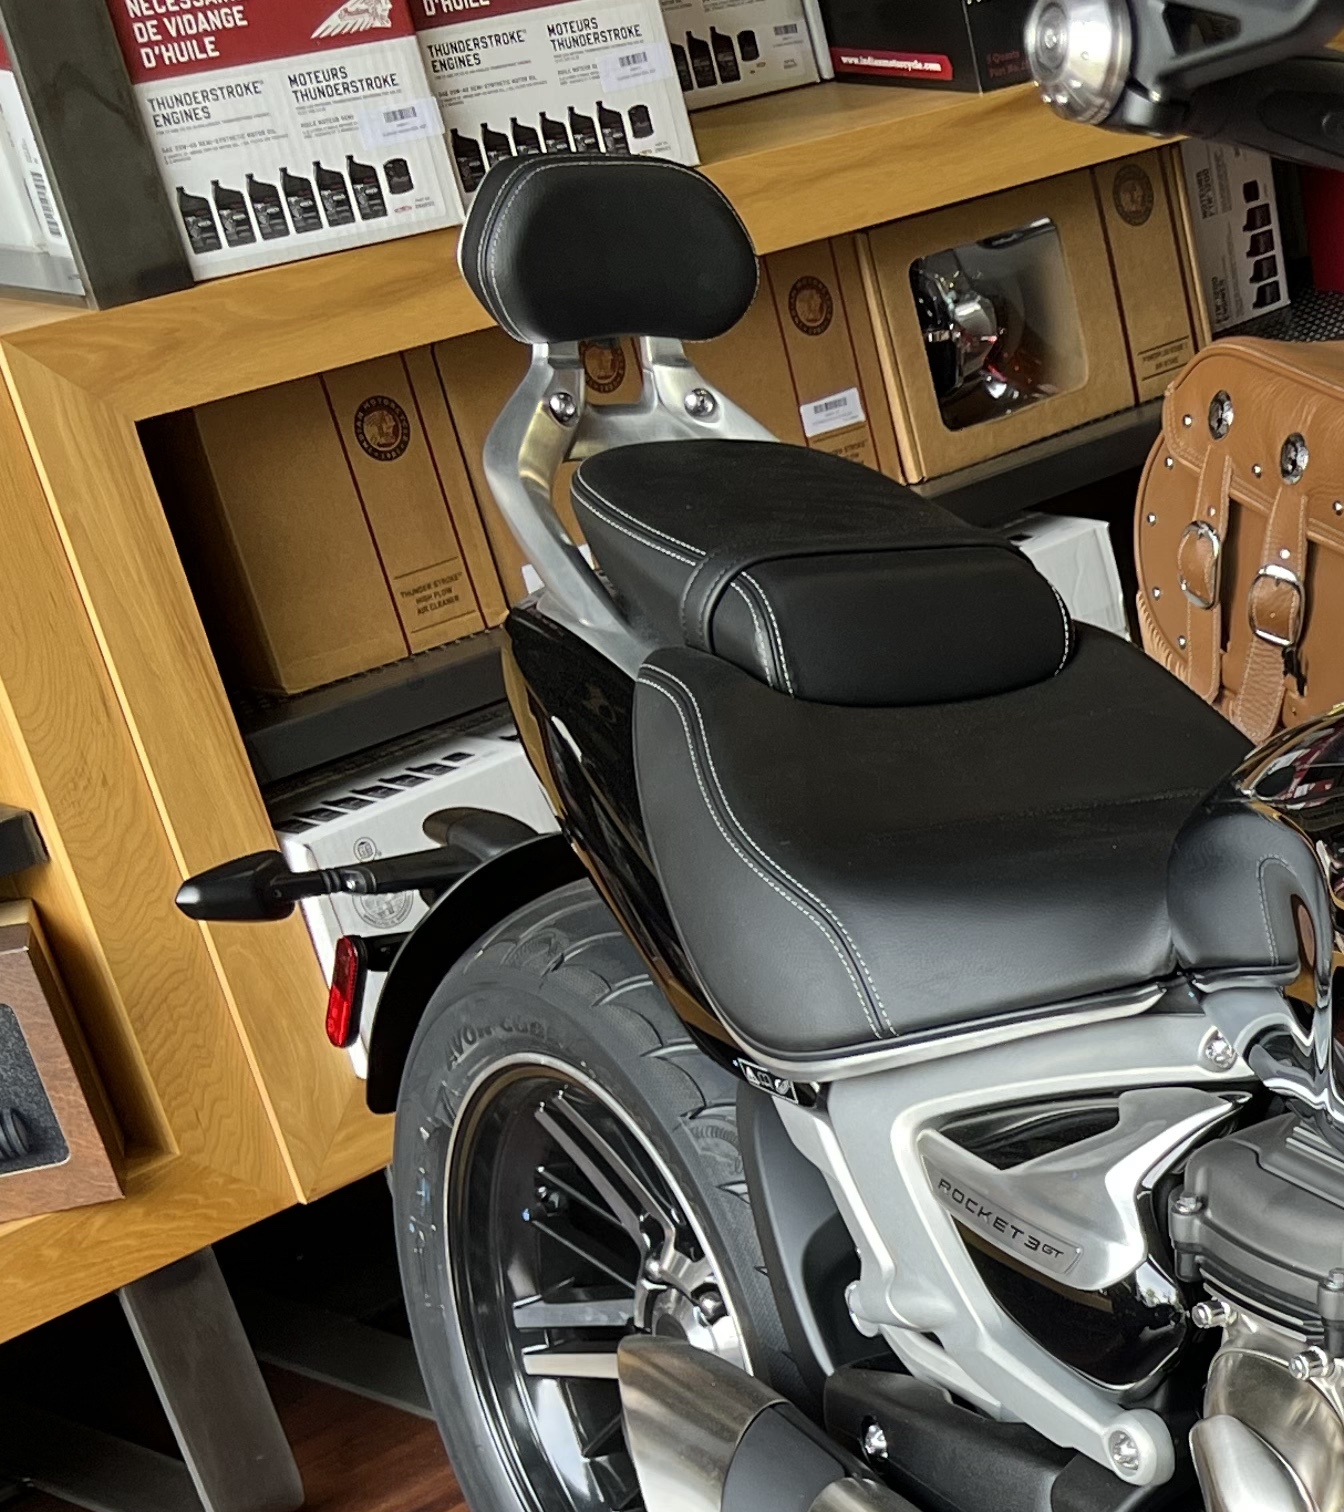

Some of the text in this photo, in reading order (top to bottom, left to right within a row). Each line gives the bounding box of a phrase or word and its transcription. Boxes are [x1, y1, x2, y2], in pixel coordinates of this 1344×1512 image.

[132, 5, 248, 43] DE VIDANGE
[547, 17, 598, 37] MOTEURS
[550, 24, 642, 51] THUNDERSTROKE
[140, 36, 220, 69] D'HUILE
[427, 31, 525, 58] THUNDERSTROKE
[431, 53, 481, 73] ENGINES
[287, 66, 348, 88] MOTEURS
[291, 73, 399, 103] THUNDERSTROKE
[148, 80, 262, 113] THUNDERSTROKE
[153, 105, 211, 128] ENGINES
